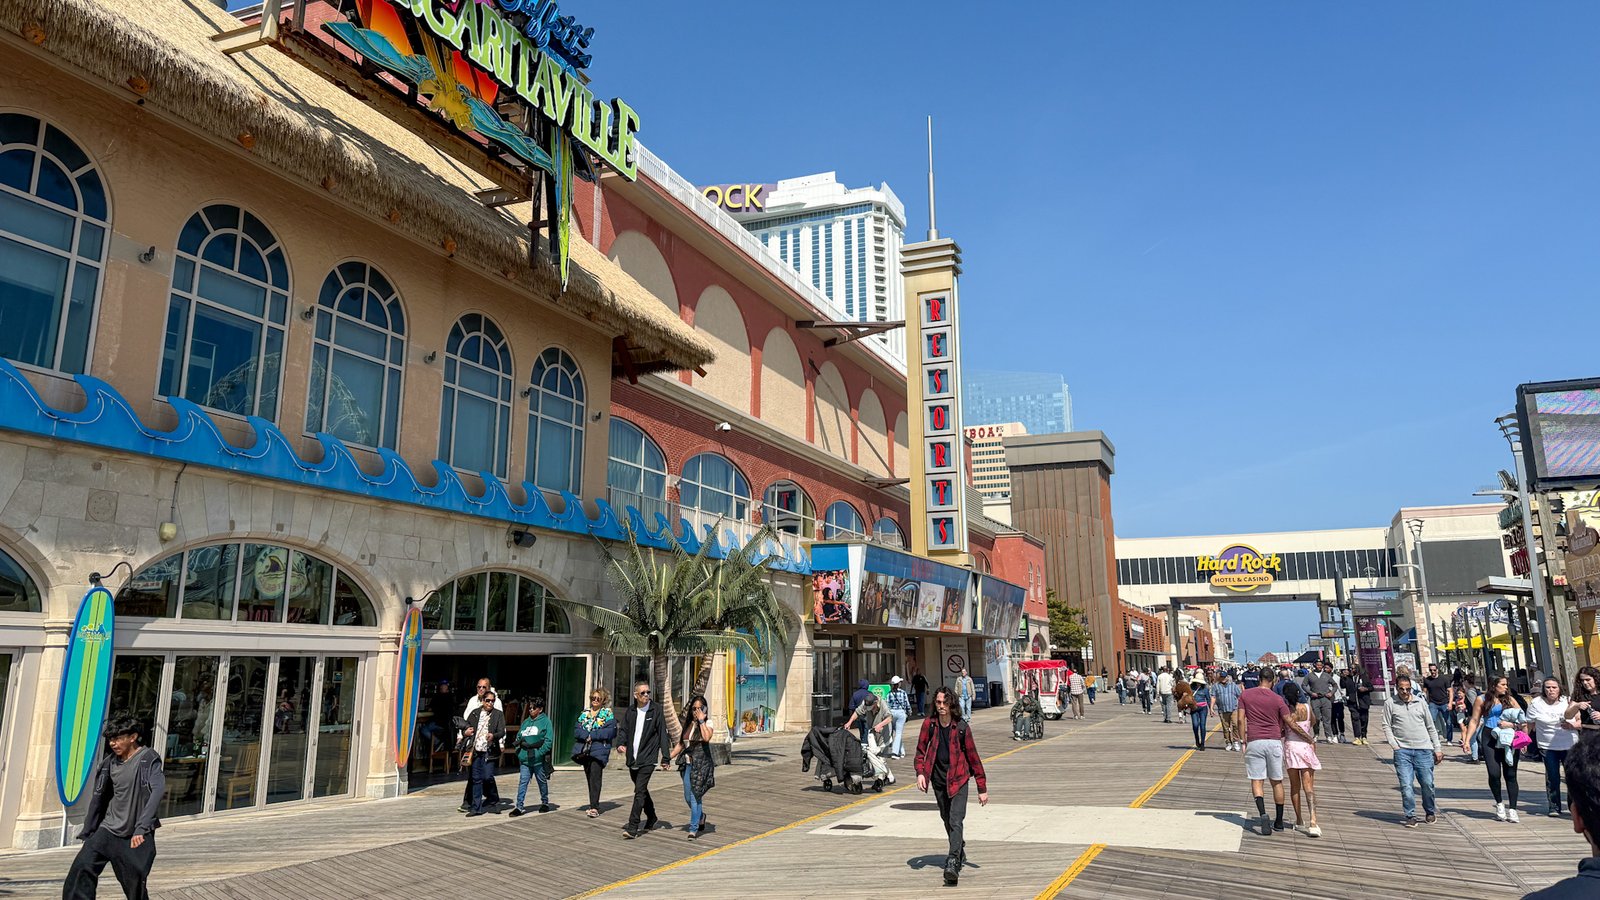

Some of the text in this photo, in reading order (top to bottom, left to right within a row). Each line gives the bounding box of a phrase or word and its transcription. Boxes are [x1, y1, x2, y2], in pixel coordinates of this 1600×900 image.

[929, 298, 948, 544] RESORTS
[1197, 552, 1282, 573] Hard Rock
